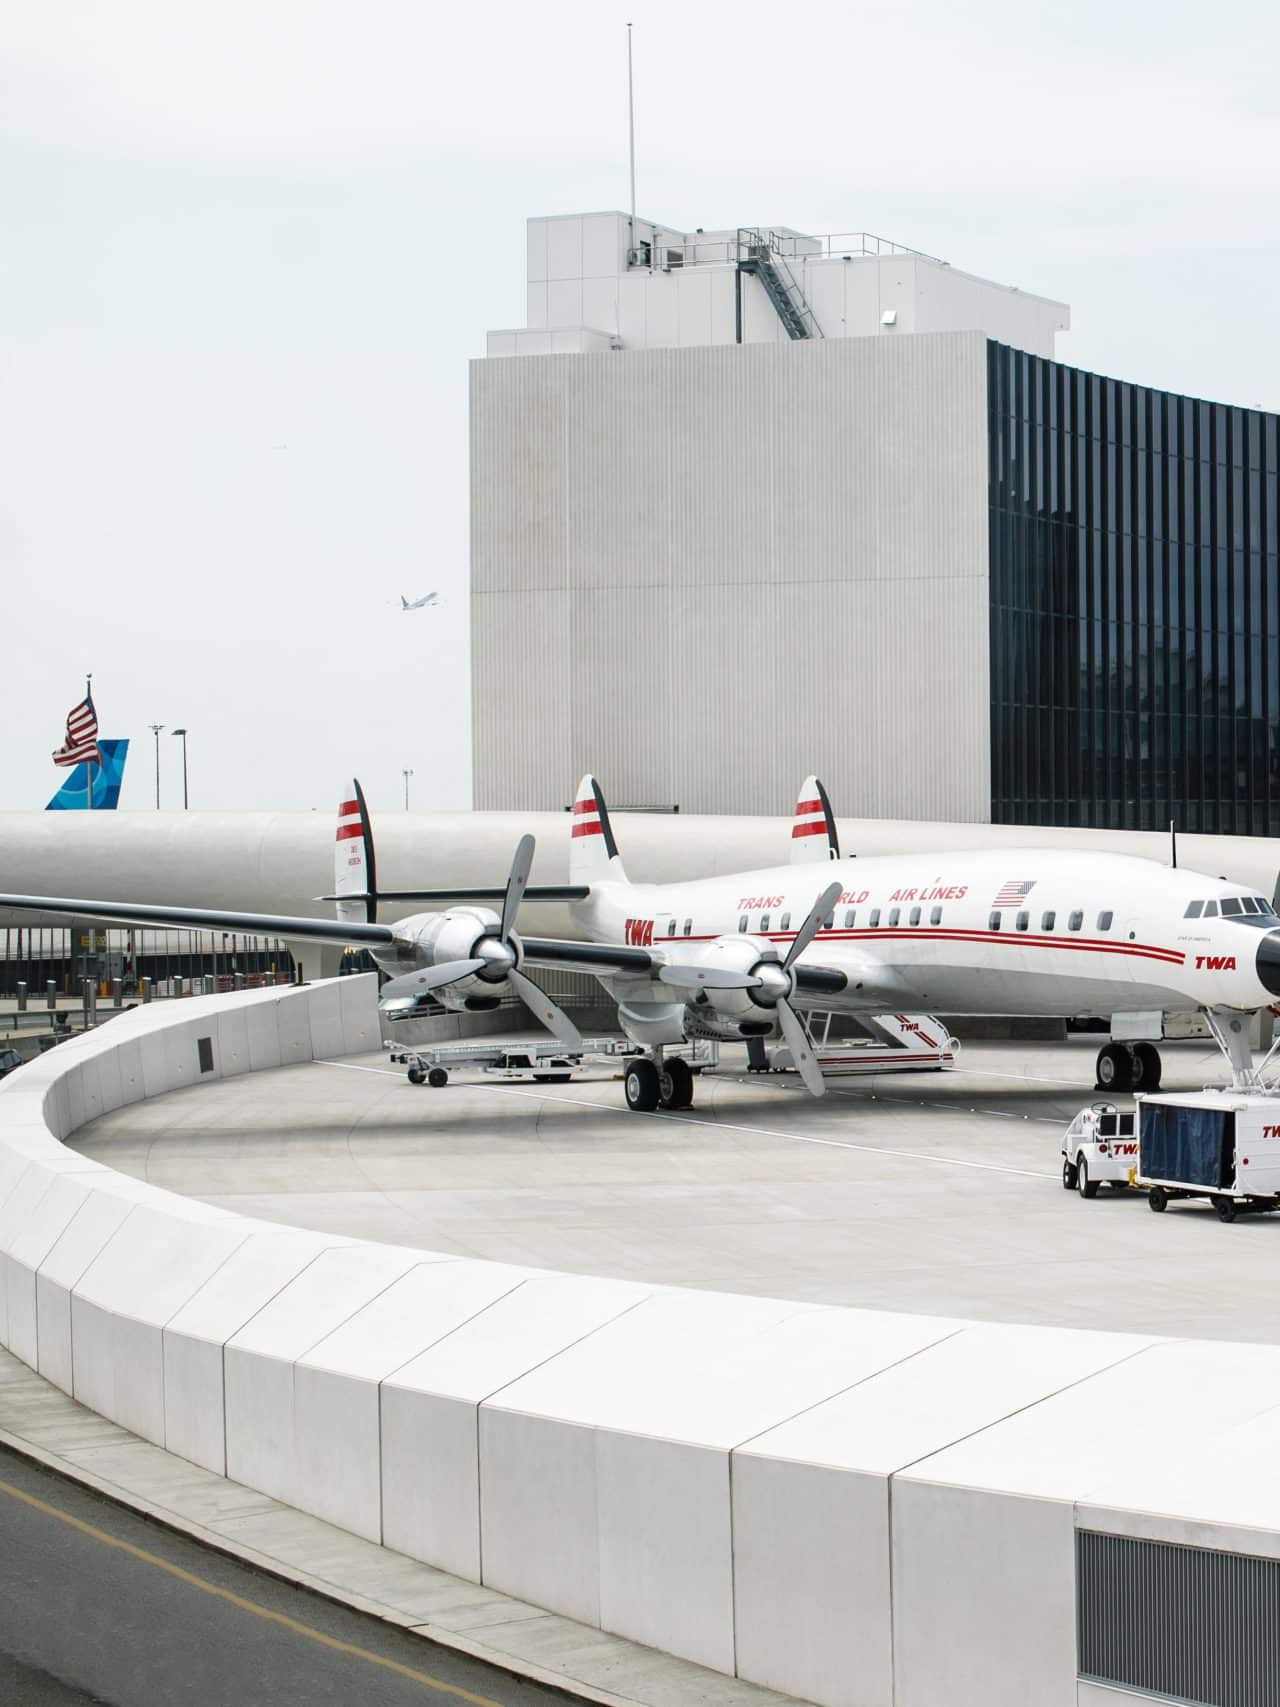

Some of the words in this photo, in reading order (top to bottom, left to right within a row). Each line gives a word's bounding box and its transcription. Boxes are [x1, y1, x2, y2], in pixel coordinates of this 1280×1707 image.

[737, 896, 784, 910] TRANS
[817, 891, 870, 905] RLD
[625, 919, 654, 946] TWA
[1195, 956, 1237, 971] TWA
[900, 1023, 920, 1032] TWA
